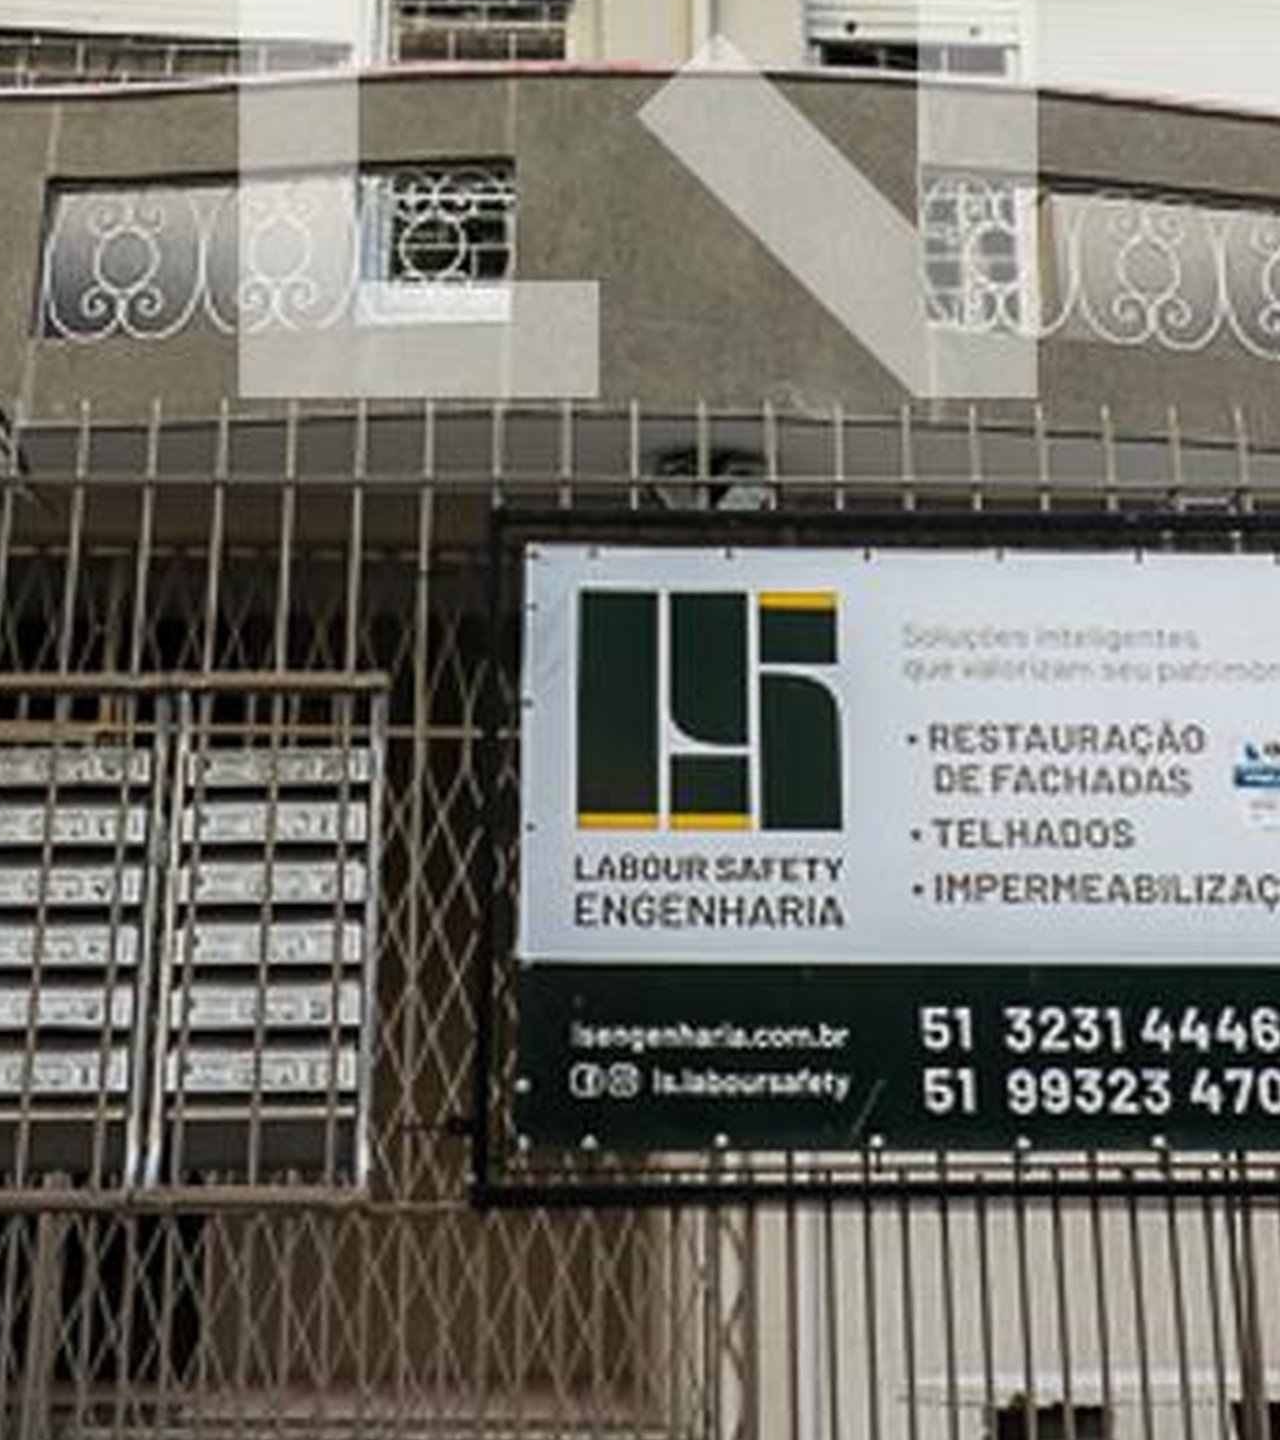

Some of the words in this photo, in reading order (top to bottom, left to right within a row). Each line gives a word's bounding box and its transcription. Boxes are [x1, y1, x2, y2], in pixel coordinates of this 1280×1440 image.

[903, 620, 1029, 654] Soluções
[1035, 623, 1199, 654] inteligentes
[903, 659, 955, 687] que
[962, 657, 1095, 683] valorizam
[1102, 661, 1152, 684] seu
[928, 721, 1205, 757] RESTAURAÇÃO
[934, 764, 981, 794] DE
[991, 764, 1193, 796] FACHADAS
[932, 819, 1136, 849] TELHADOS
[574, 854, 708, 882] LABOUR
[715, 855, 843, 882] SAFETY
[574, 893, 845, 927] ENGENHARIA
[920, 1007, 972, 1051] 51
[1004, 1007, 1124, 1051] 3231
[923, 1068, 978, 1114] 51
[1007, 1068, 1171, 1114] 99323
